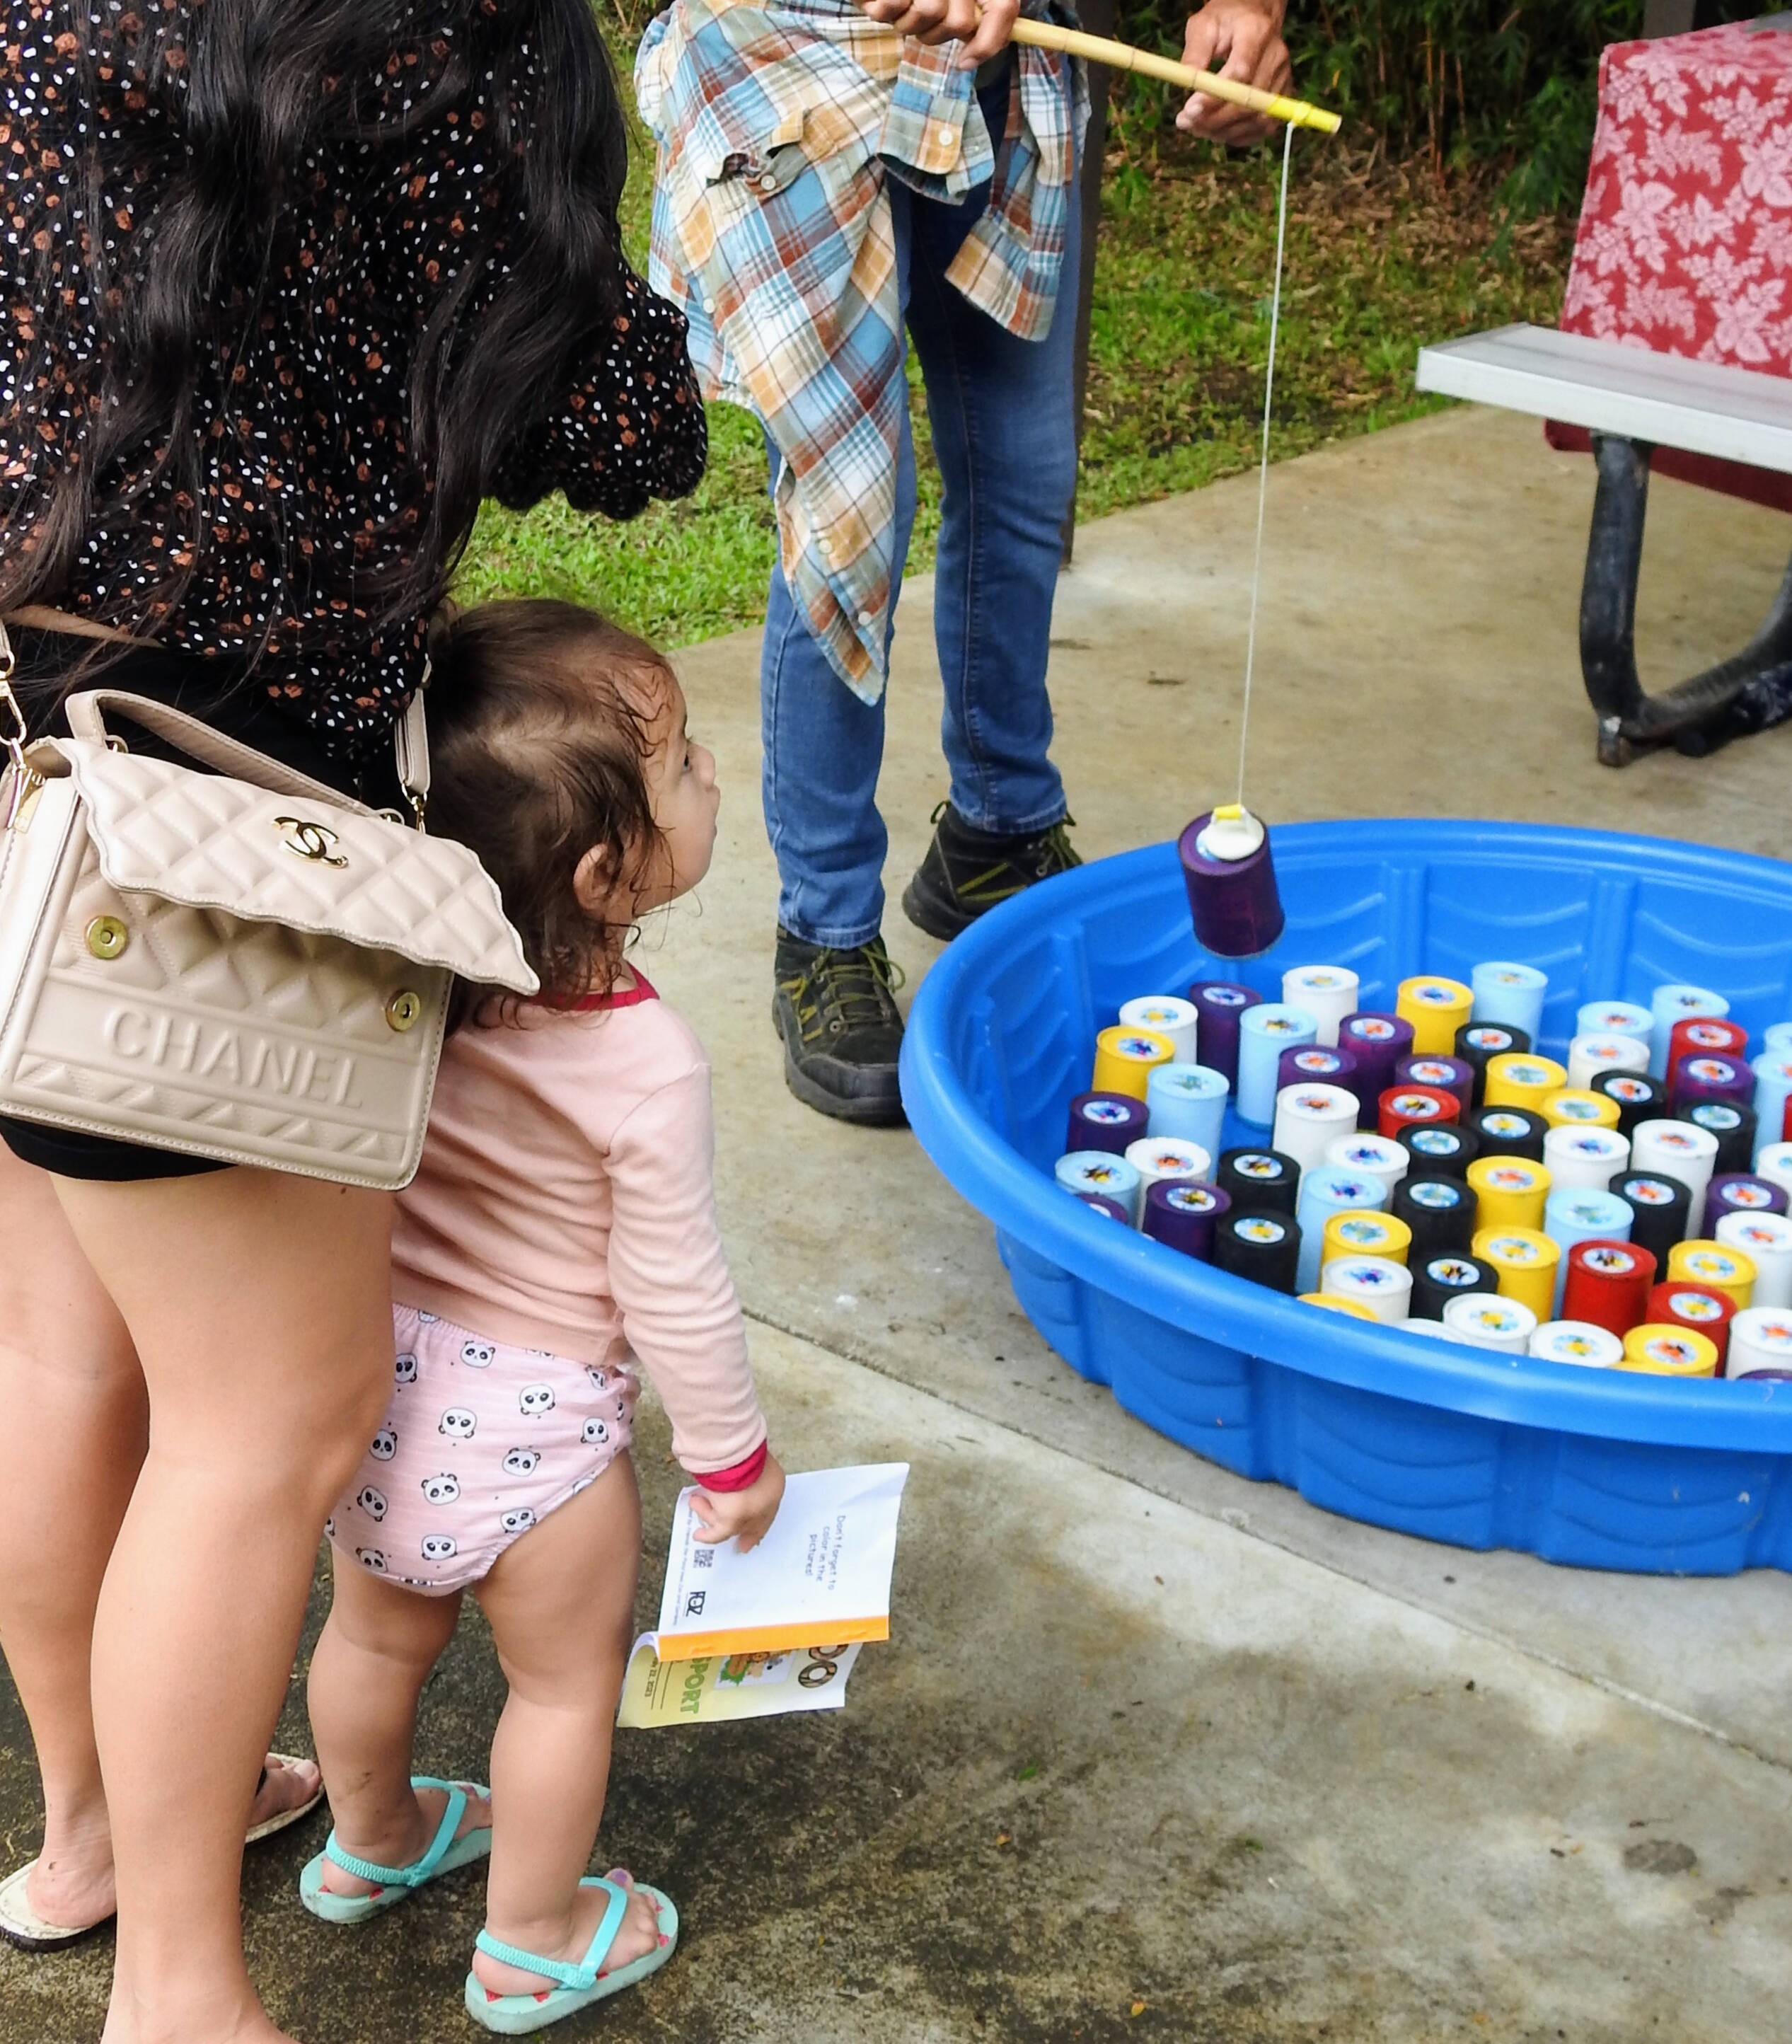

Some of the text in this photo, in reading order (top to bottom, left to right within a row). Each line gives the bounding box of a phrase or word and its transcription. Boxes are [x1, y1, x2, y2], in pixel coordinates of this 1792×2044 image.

[104, 1007, 362, 1109] CHANEL
[816, 1525, 831, 1582] color in the
[828, 1515, 846, 1590] Don't forget to
